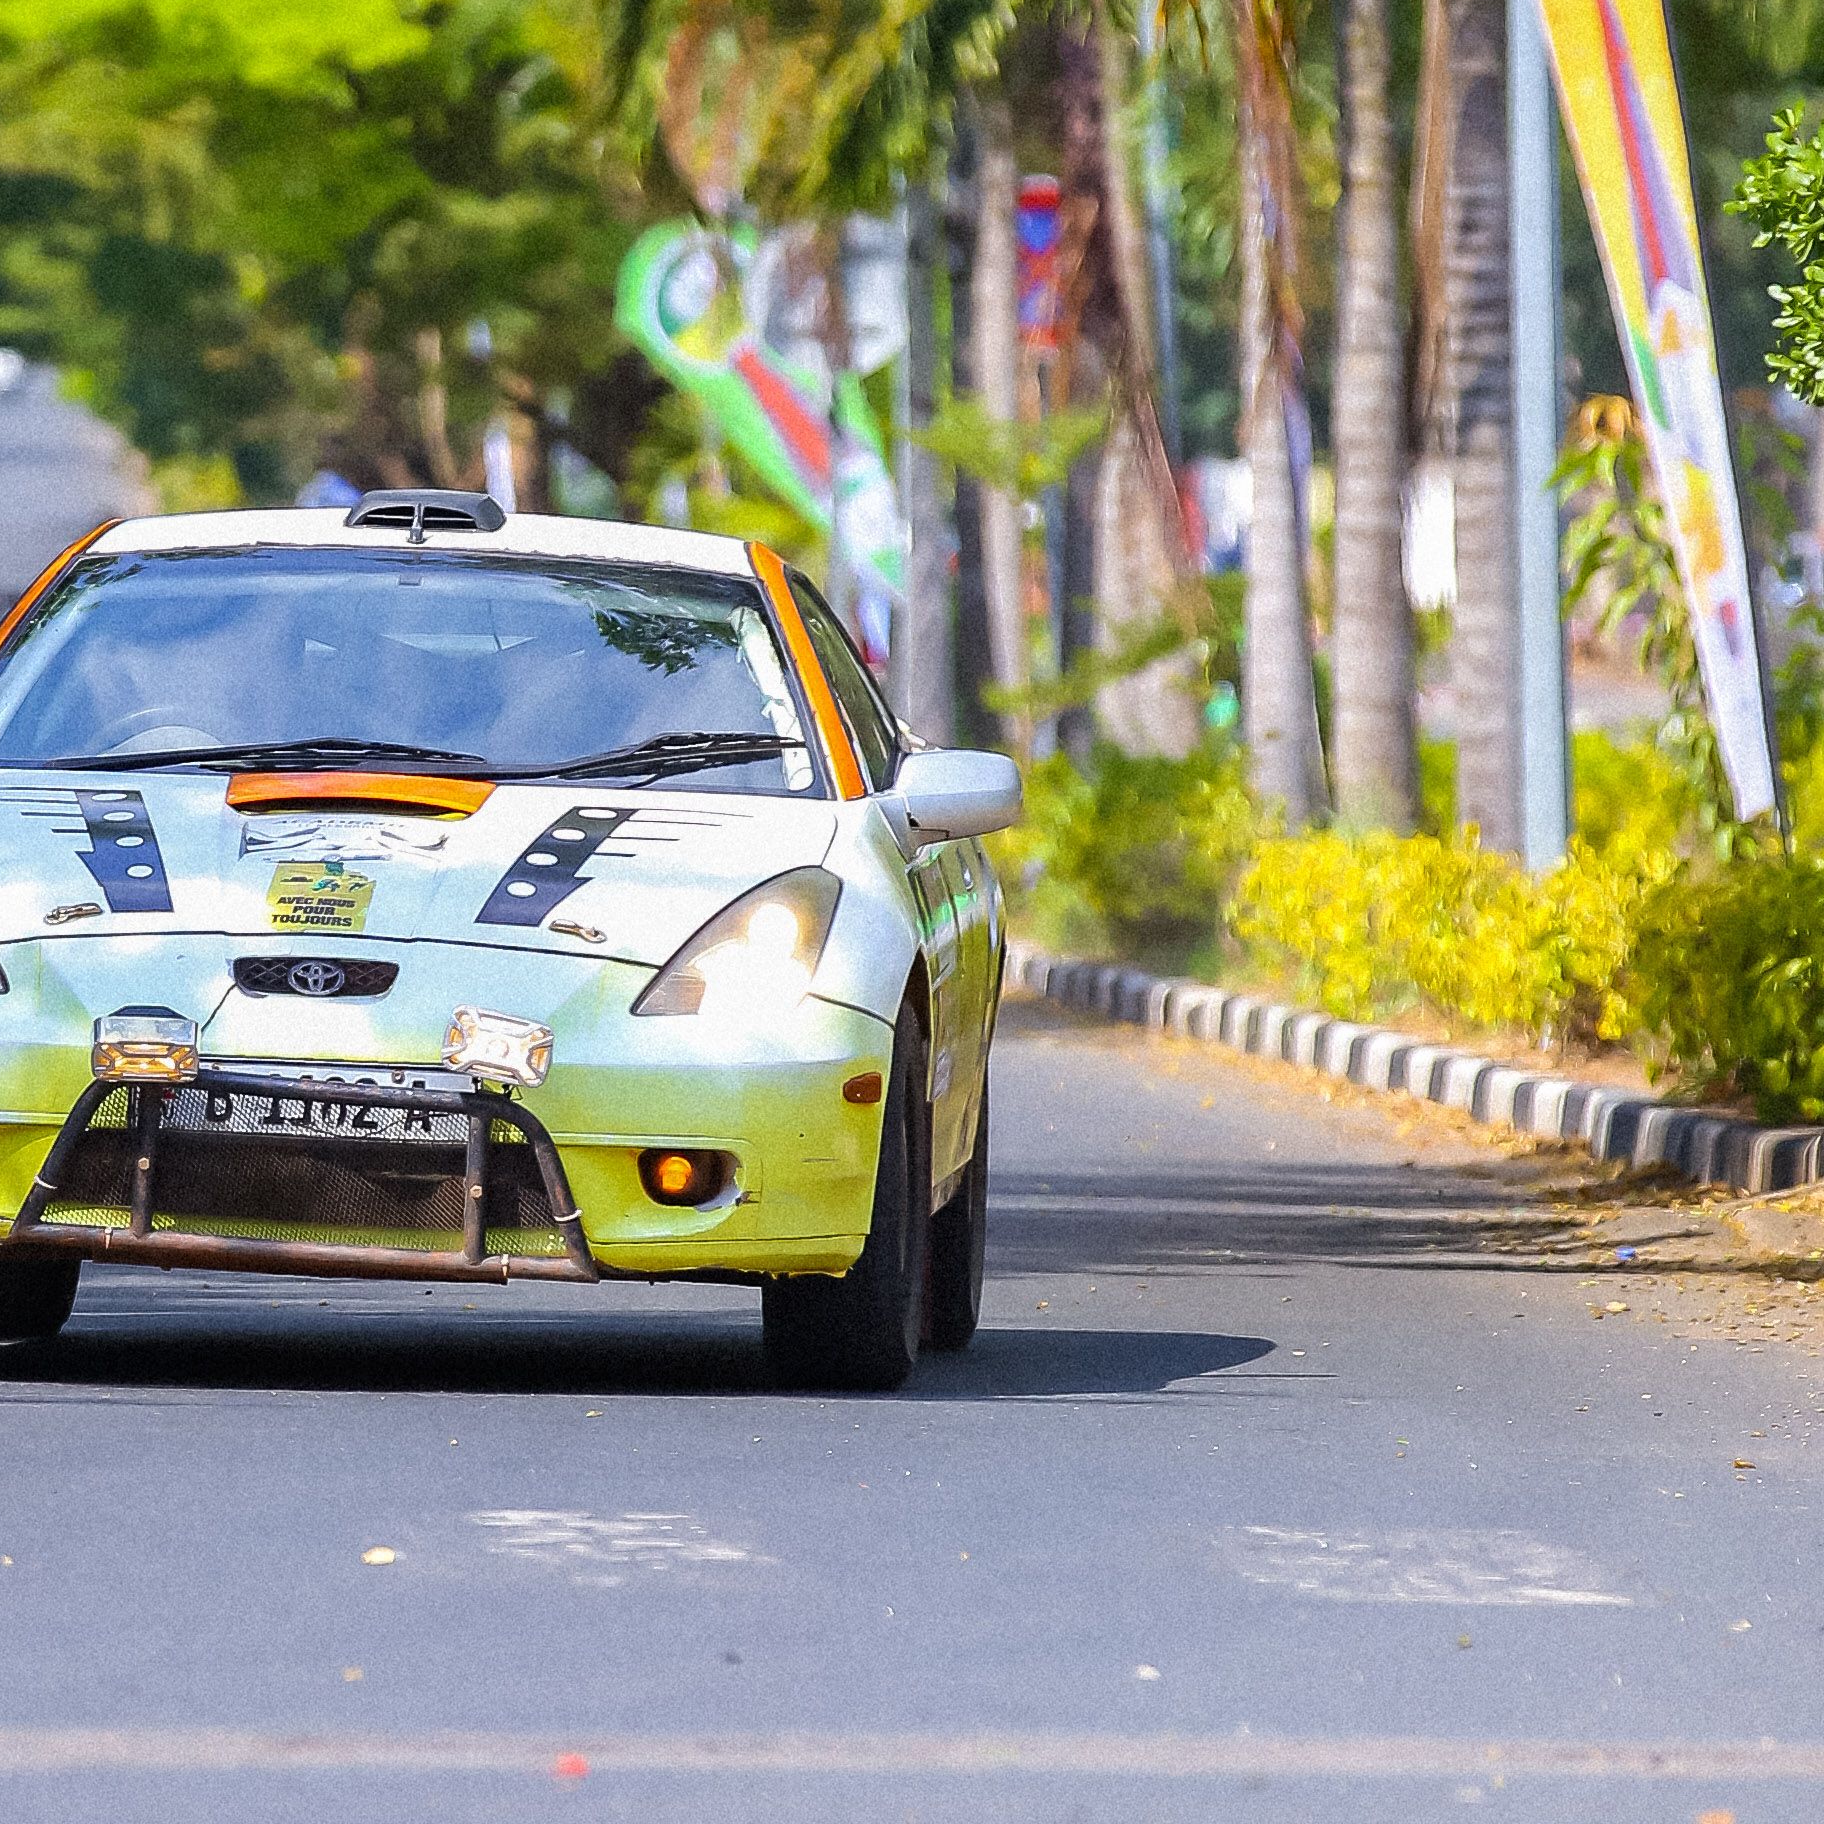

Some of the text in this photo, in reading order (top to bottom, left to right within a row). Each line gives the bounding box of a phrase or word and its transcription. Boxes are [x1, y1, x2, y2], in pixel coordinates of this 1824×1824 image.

[277, 896, 356, 908] AVEC NOUS
[293, 906, 335, 915] POUR
[272, 915, 353, 927] TOUJOURS
